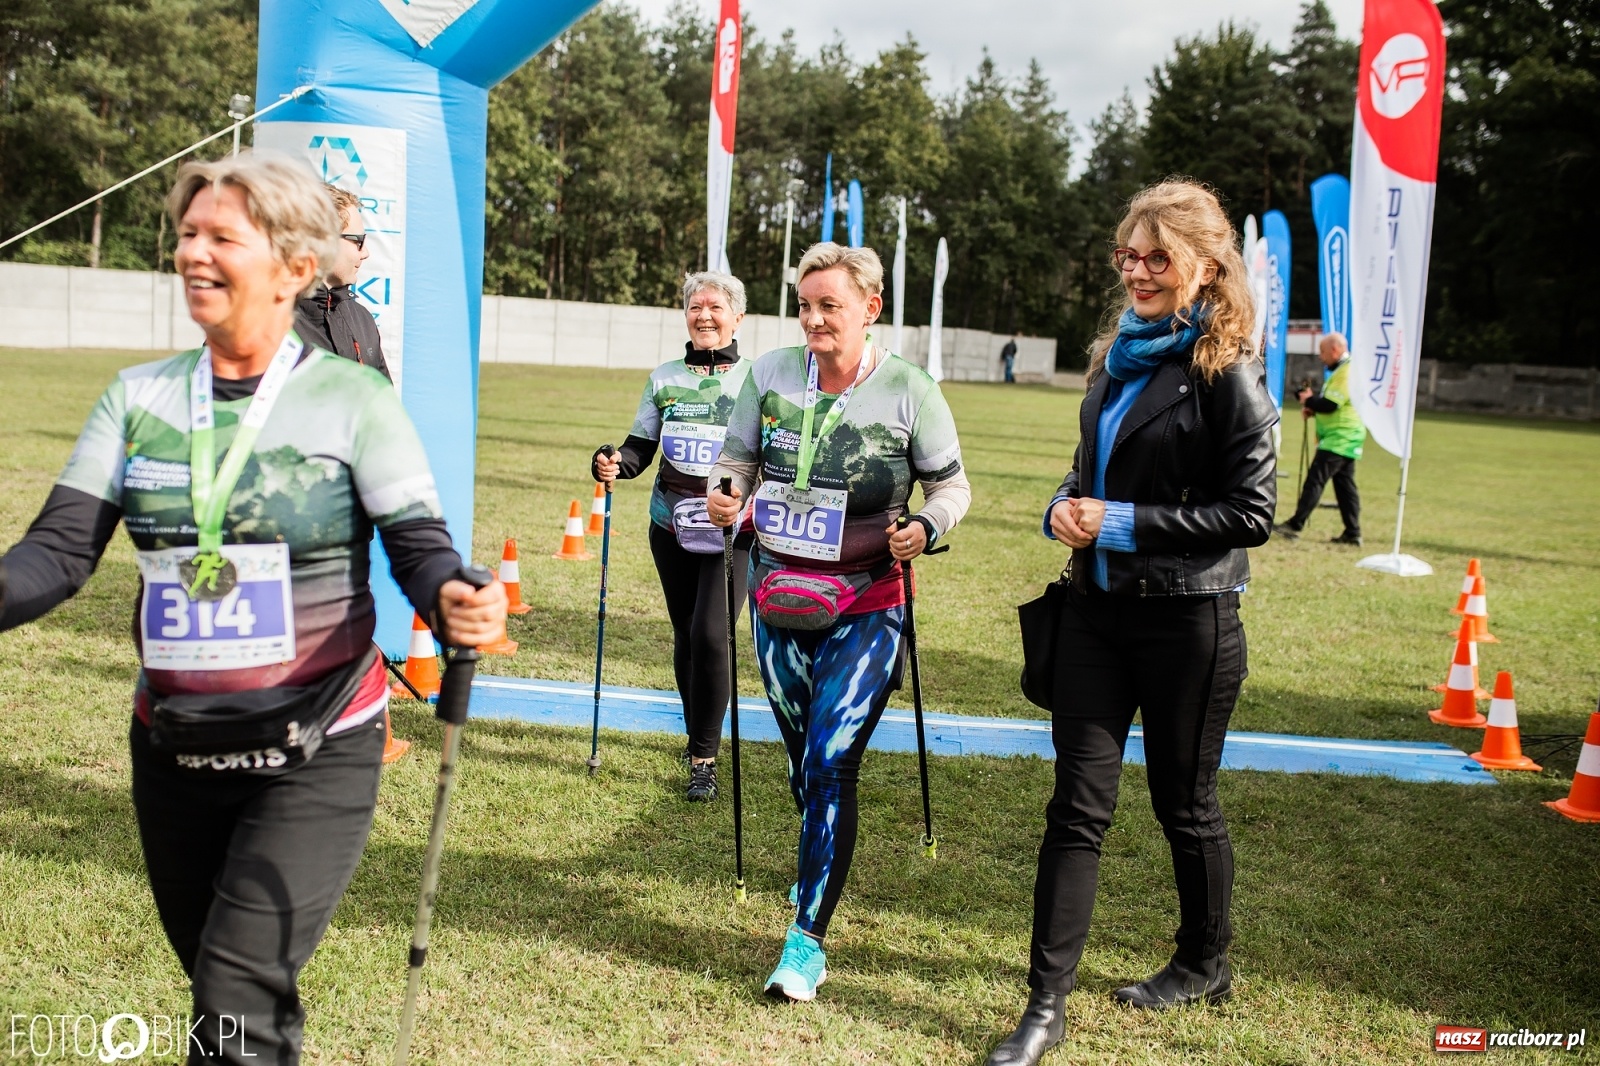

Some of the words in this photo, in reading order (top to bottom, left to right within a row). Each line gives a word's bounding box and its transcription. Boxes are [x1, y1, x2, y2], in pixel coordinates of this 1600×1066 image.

[673, 439, 713, 464] 316
[765, 504, 828, 540] 306
[161, 586, 257, 639] 314
[176, 747, 287, 770] SPORTS
